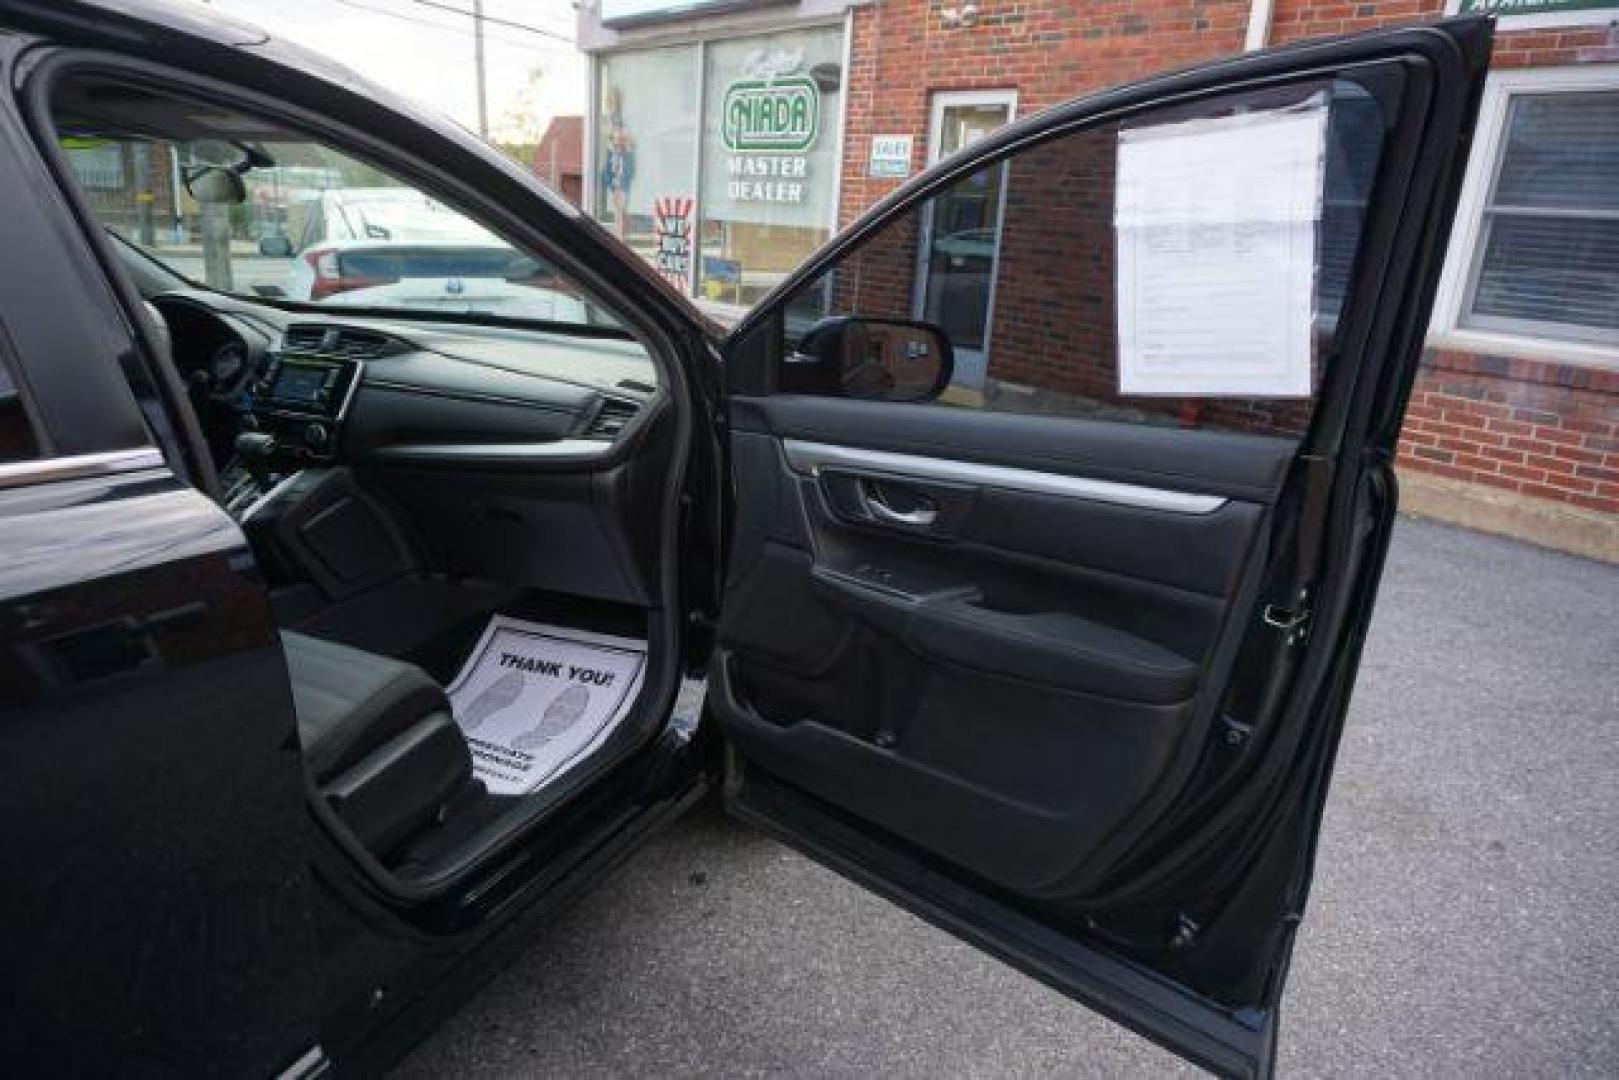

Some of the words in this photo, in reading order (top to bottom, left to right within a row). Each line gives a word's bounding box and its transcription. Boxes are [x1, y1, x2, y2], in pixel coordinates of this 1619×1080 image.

[729, 94, 809, 132] NIADA
[728, 155, 807, 178] MASTER
[728, 180, 802, 203] DEALER
[500, 652, 562, 677] THANK
